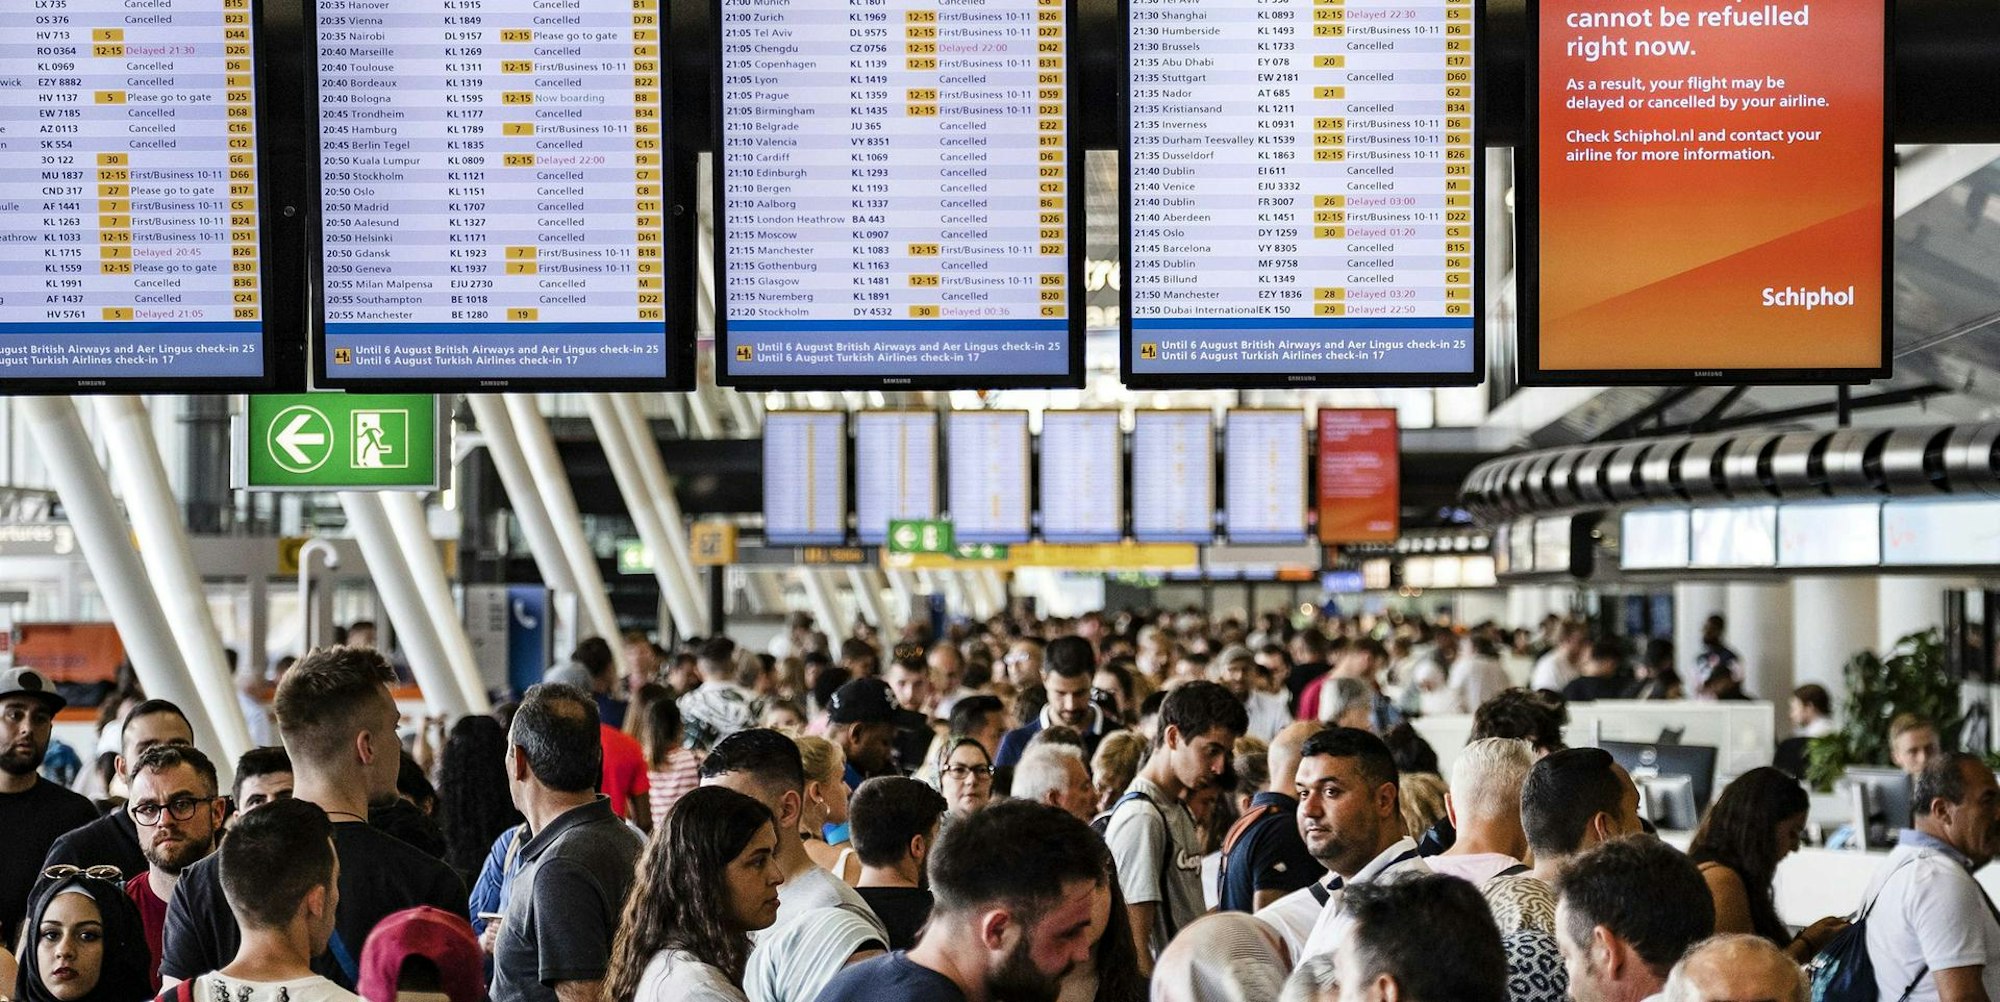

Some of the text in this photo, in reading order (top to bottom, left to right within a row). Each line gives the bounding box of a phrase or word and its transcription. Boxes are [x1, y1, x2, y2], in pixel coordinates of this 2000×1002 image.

[320, 16, 653, 25] 20:35 Vienna KL 1849 Cancelled D78
[1566, 2, 1809, 28] cannot be refuelled
[1567, 35, 1696, 62] right now.
[1133, 57, 1464, 66] 21:35 Abu Dhabi EY 078 20 E17
[1566, 76, 1785, 93] As a result, your flight may be
[726, 90, 1058, 101] 21:05 Prague KL 1359 12-15 First/Business 10-11 D59
[1566, 94, 1829, 112] delayed or cancelled by your airline.
[1566, 128, 1822, 145] Check Schiphol.nl and contact your
[1566, 147, 1775, 161] airline for more information.
[44, 231, 250, 242] KL 1033 12-15 First/Business 10-11 D51
[1135, 289, 1454, 300] 21:50 Manchester EZY 1836 28 Delayed 03:20 H
[1762, 286, 1854, 310] Schiphol
[63, 310, 85, 318] 5761
[115, 310, 121, 318] 5
[135, 309, 173, 320] Delayed
[178, 310, 204, 318] 21:05
[234, 309, 254, 318] D85
[730, 307, 1054, 318] 21:20 Stockholm DY 4532 30 Delayed 00:36 C5
[30, 344, 65, 354] British
[68, 344, 111, 356] Airways
[114, 344, 134, 354] and
[136, 344, 156, 354] Aer
[159, 344, 193, 356] Lingus
[196, 344, 239, 353] check-in
[242, 344, 255, 353] 25
[356, 344, 659, 356] Until 6 August British Airways and Aer Lingus check-in 25
[757, 341, 1060, 354] Until 6 August British Airways and Aer Lingus check-in 25
[1162, 339, 1466, 352] Until 6 August British Airways and Aer Lingus check-in 25
[31, 355, 68, 364] Turkish
[72, 354, 112, 364] Airlines
[115, 354, 158, 364] check-in
[162, 355, 174, 364] 17
[356, 355, 578, 367] Until 6 August Turkish Airlines check-in 17
[757, 352, 980, 364] Until 6 August Turkish Airlines check-in 17
[1162, 350, 1384, 362] Until 6 August Turkish Airlines check-in 17
